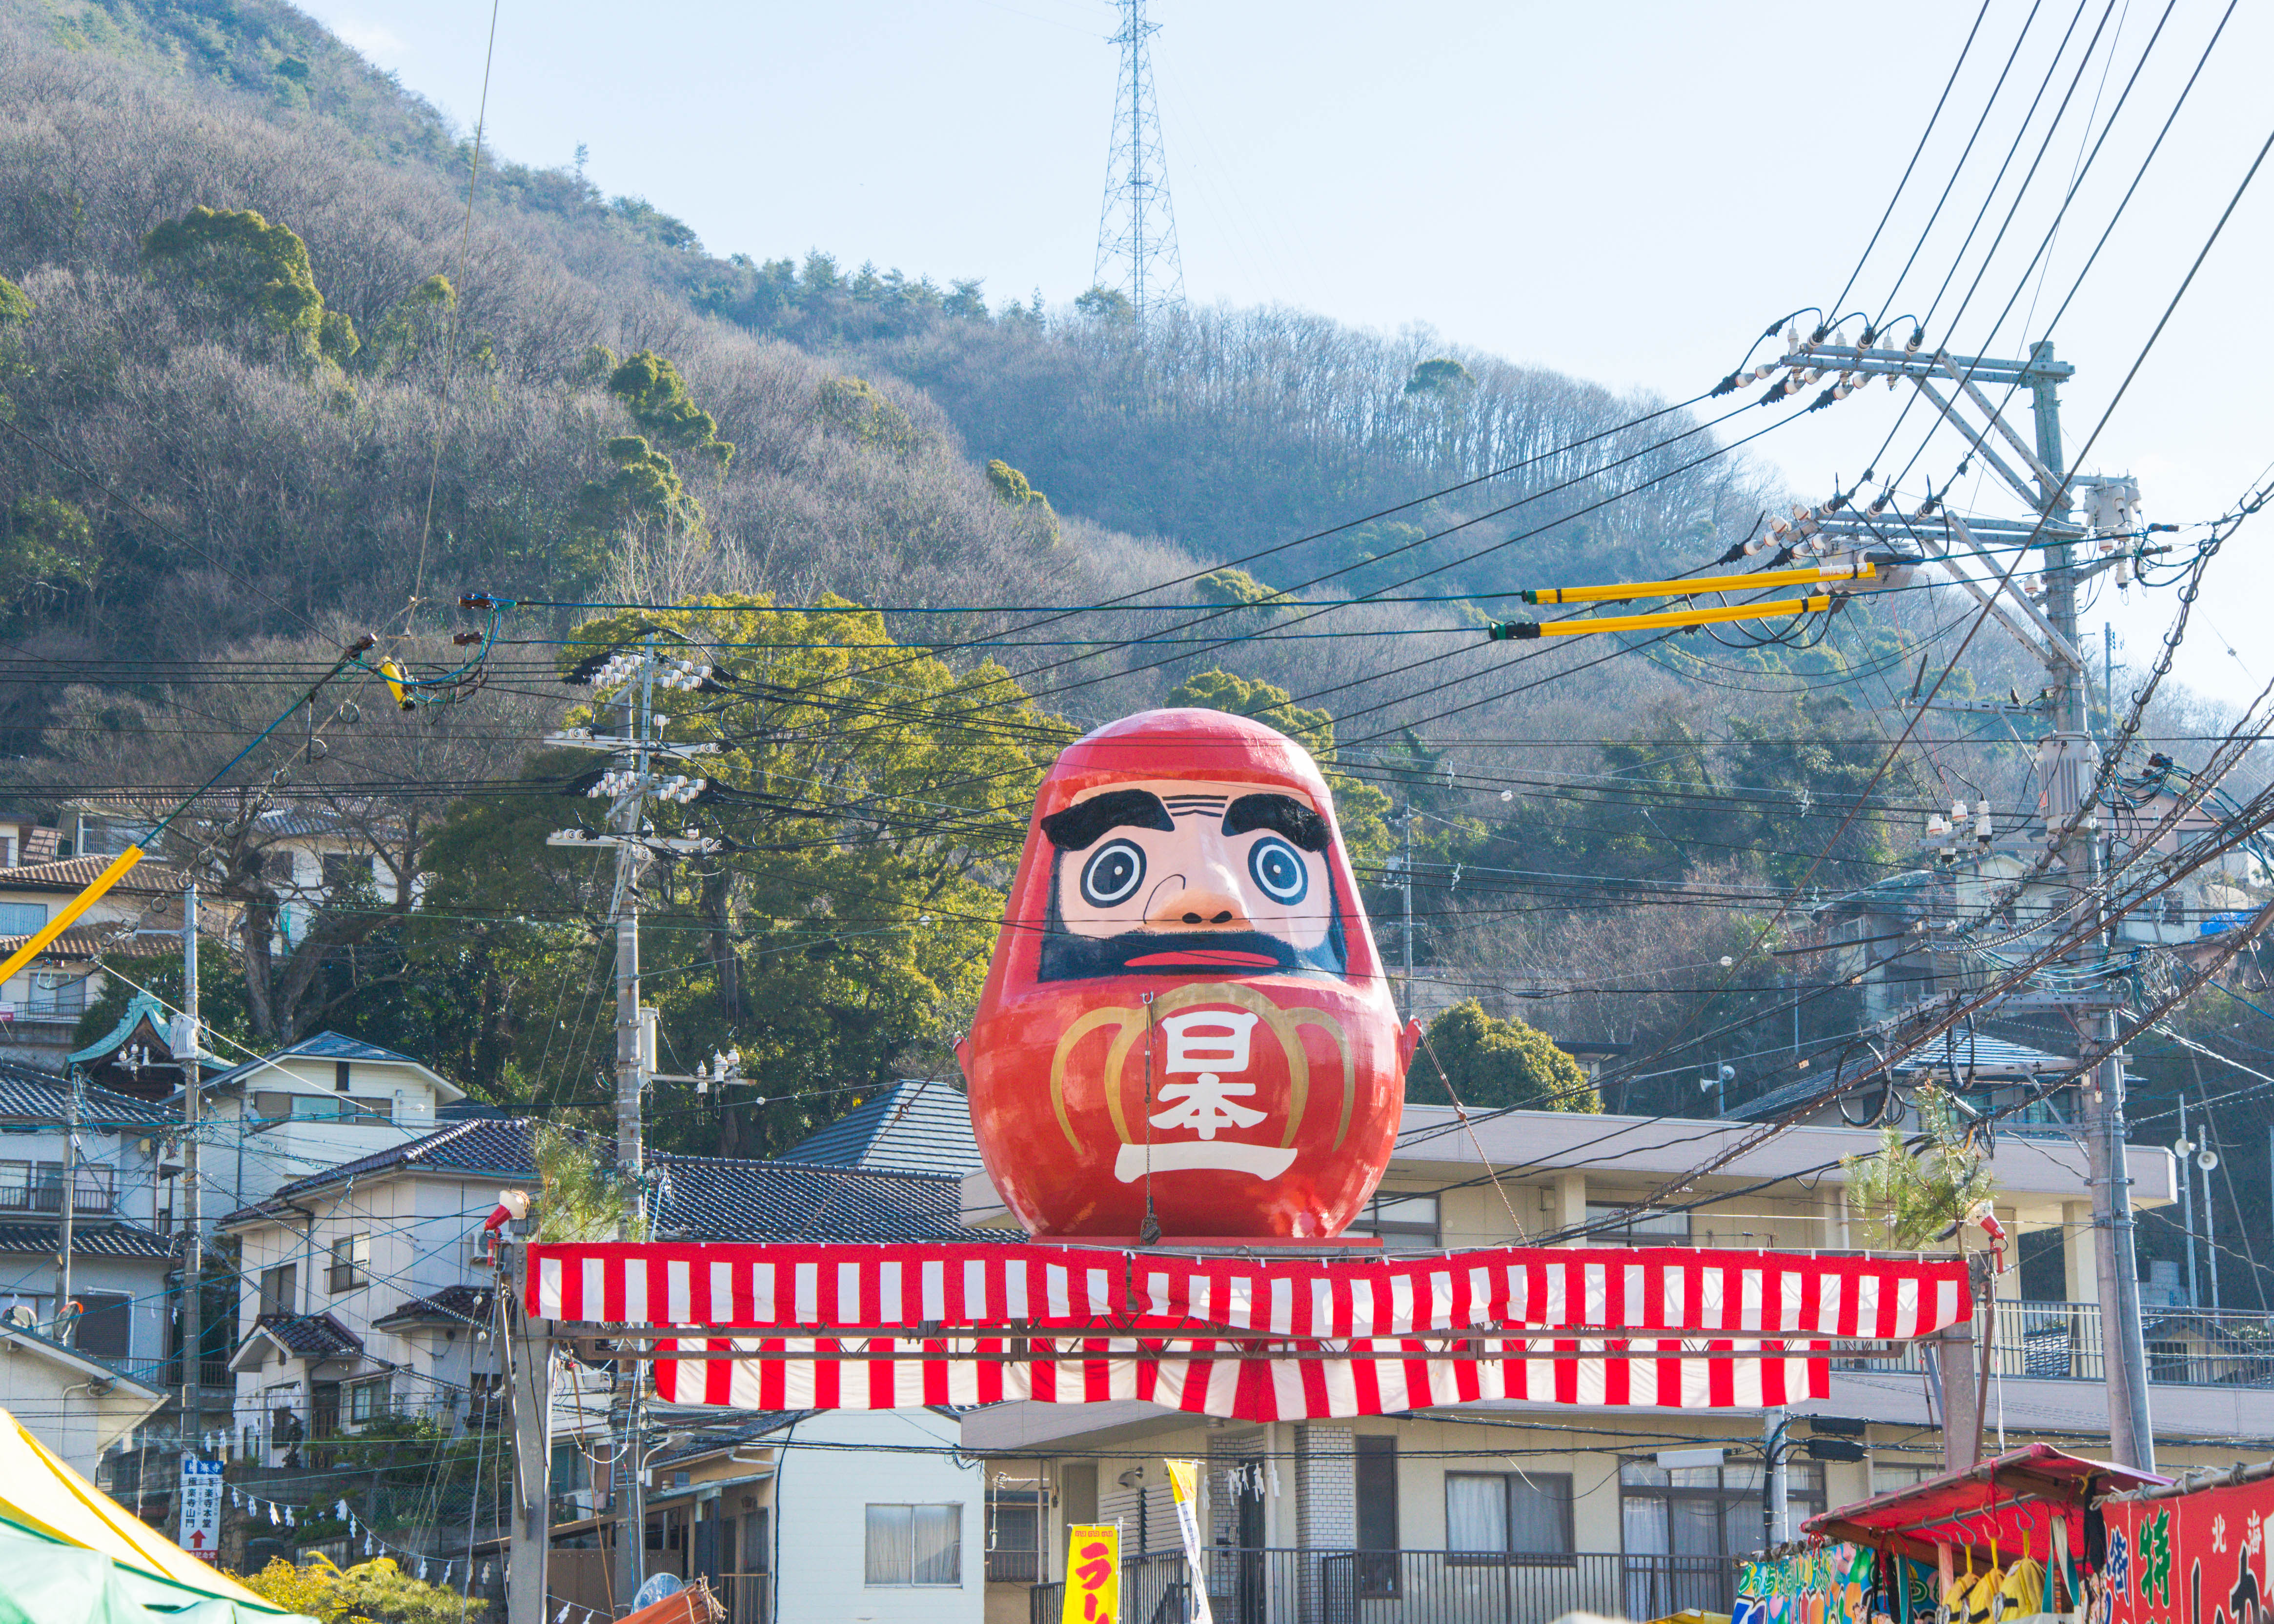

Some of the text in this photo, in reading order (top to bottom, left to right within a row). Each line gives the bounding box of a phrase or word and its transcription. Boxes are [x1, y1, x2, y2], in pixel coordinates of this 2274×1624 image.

[1115, 1011, 1298, 1183] 日本一
[186, 1477, 197, 1527] 極楽寺山門
[1076, 1543, 1112, 1624] ラー
